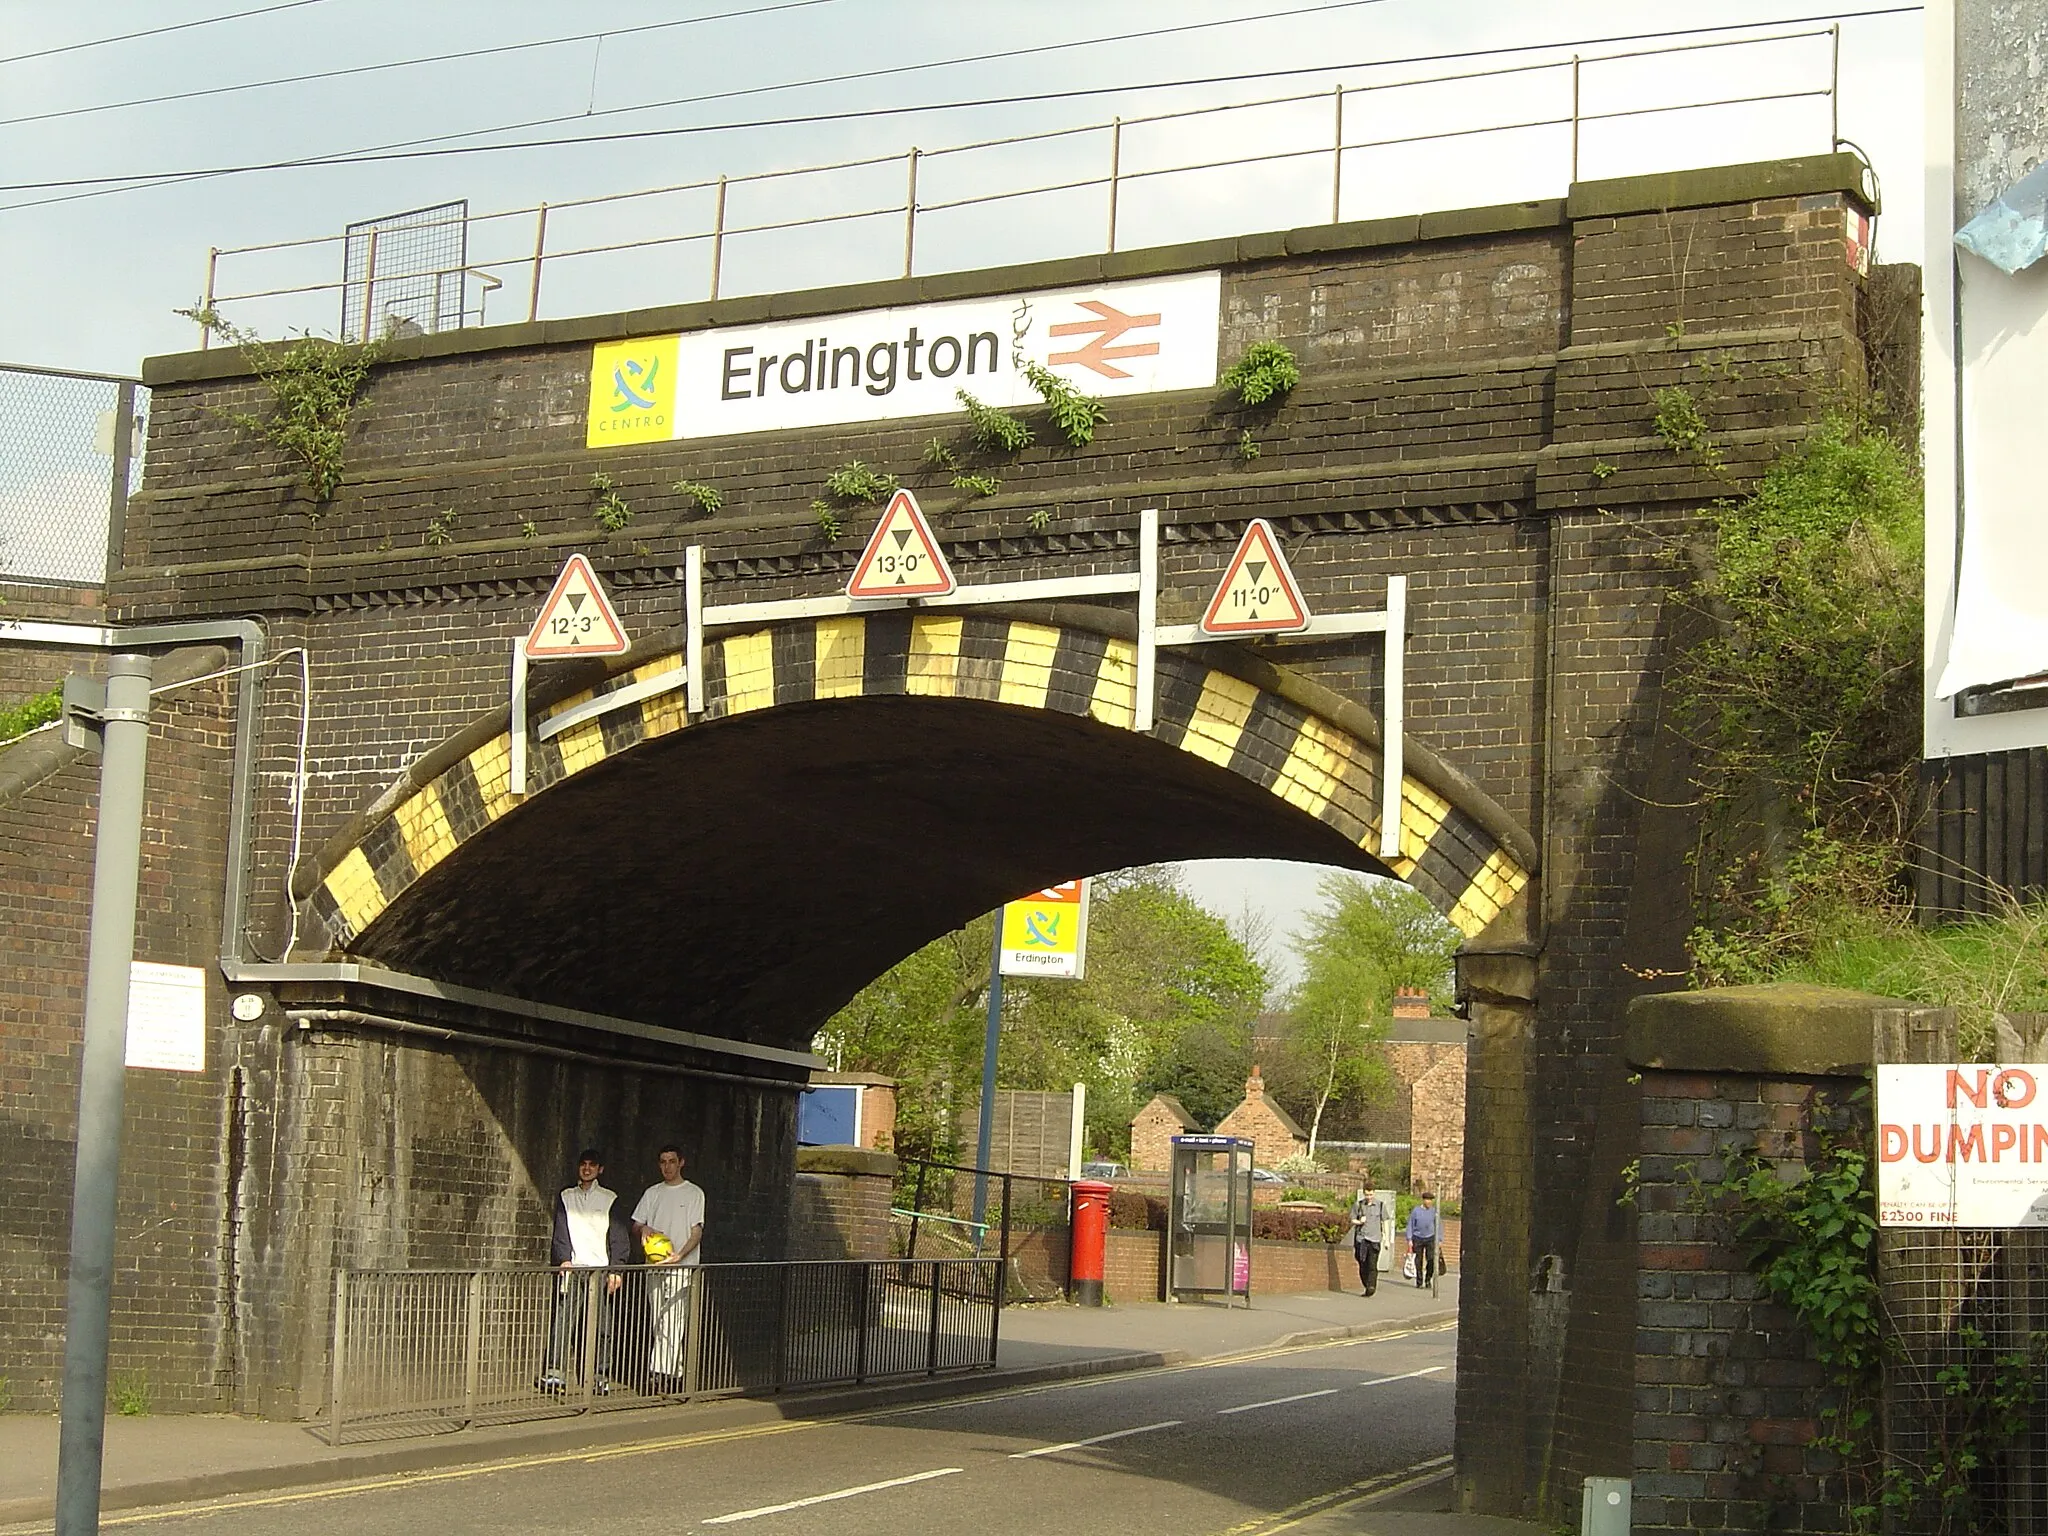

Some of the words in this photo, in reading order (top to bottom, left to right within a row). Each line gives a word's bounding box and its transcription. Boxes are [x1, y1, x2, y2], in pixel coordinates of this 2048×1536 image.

[721, 327, 999, 400] Erdington
[599, 414, 665, 431] CENTRO
[1015, 952, 1064, 965] Erdington
[1946, 1068, 2037, 1109] NO
[1881, 1211, 1924, 1222] £2500
[1930, 1212, 1958, 1222] FINE
